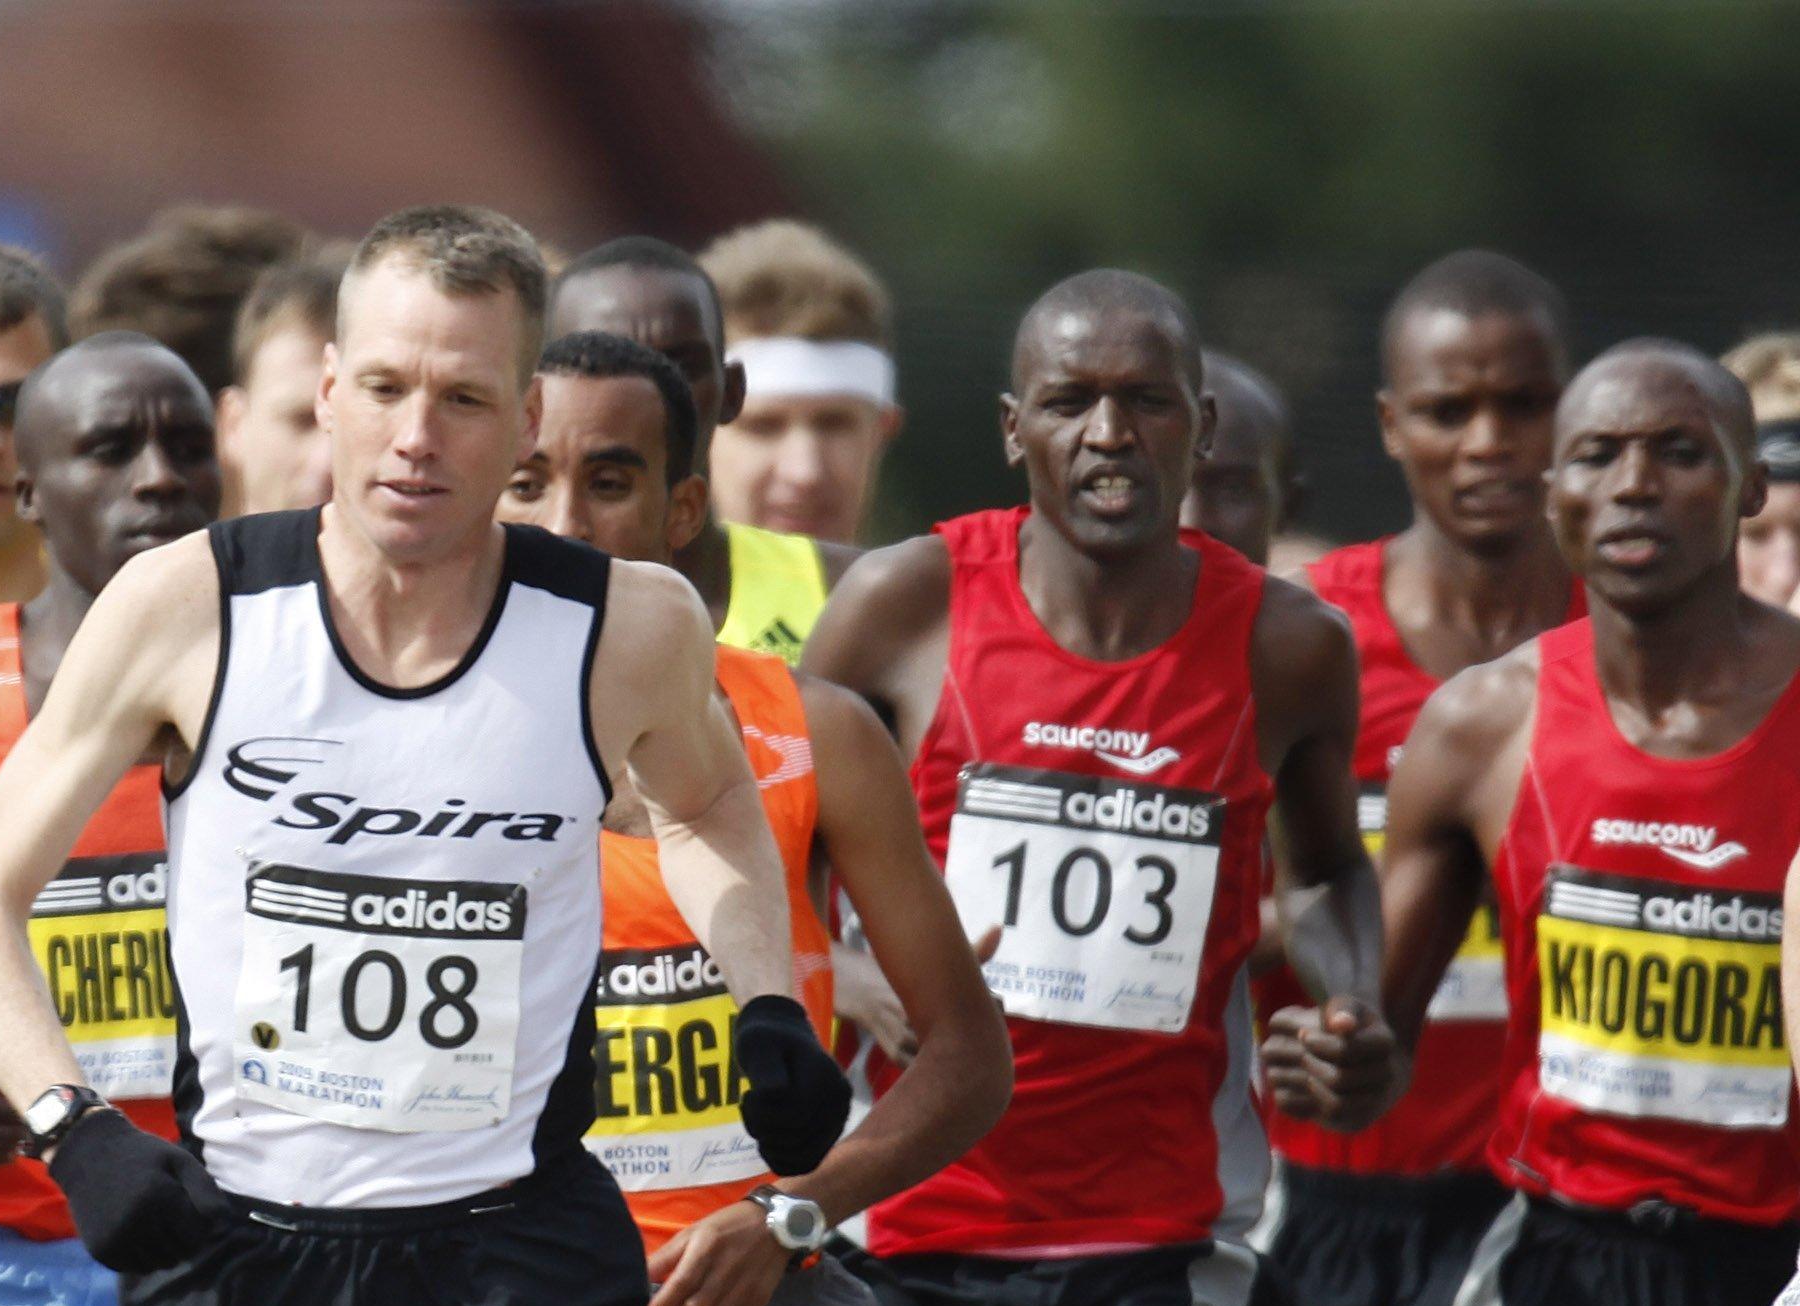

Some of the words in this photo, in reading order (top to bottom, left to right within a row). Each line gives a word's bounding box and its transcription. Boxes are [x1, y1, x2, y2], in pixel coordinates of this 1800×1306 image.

[1021, 721, 1151, 757] saucony
[271, 791, 565, 845] Spira
[1065, 788, 1211, 838] adidas
[1590, 818, 1717, 852] saucony
[351, 889, 512, 932] adidas
[991, 839, 1178, 946] 103
[280, 942, 479, 1050] 108
[1549, 941, 1783, 1049] KIOGORA
[279, 1078, 381, 1110] MARATHON
[319, 1070, 383, 1091] BOSTON
[604, 1144, 669, 1160] BOSTON
[610, 1160, 671, 1176] ATHON
